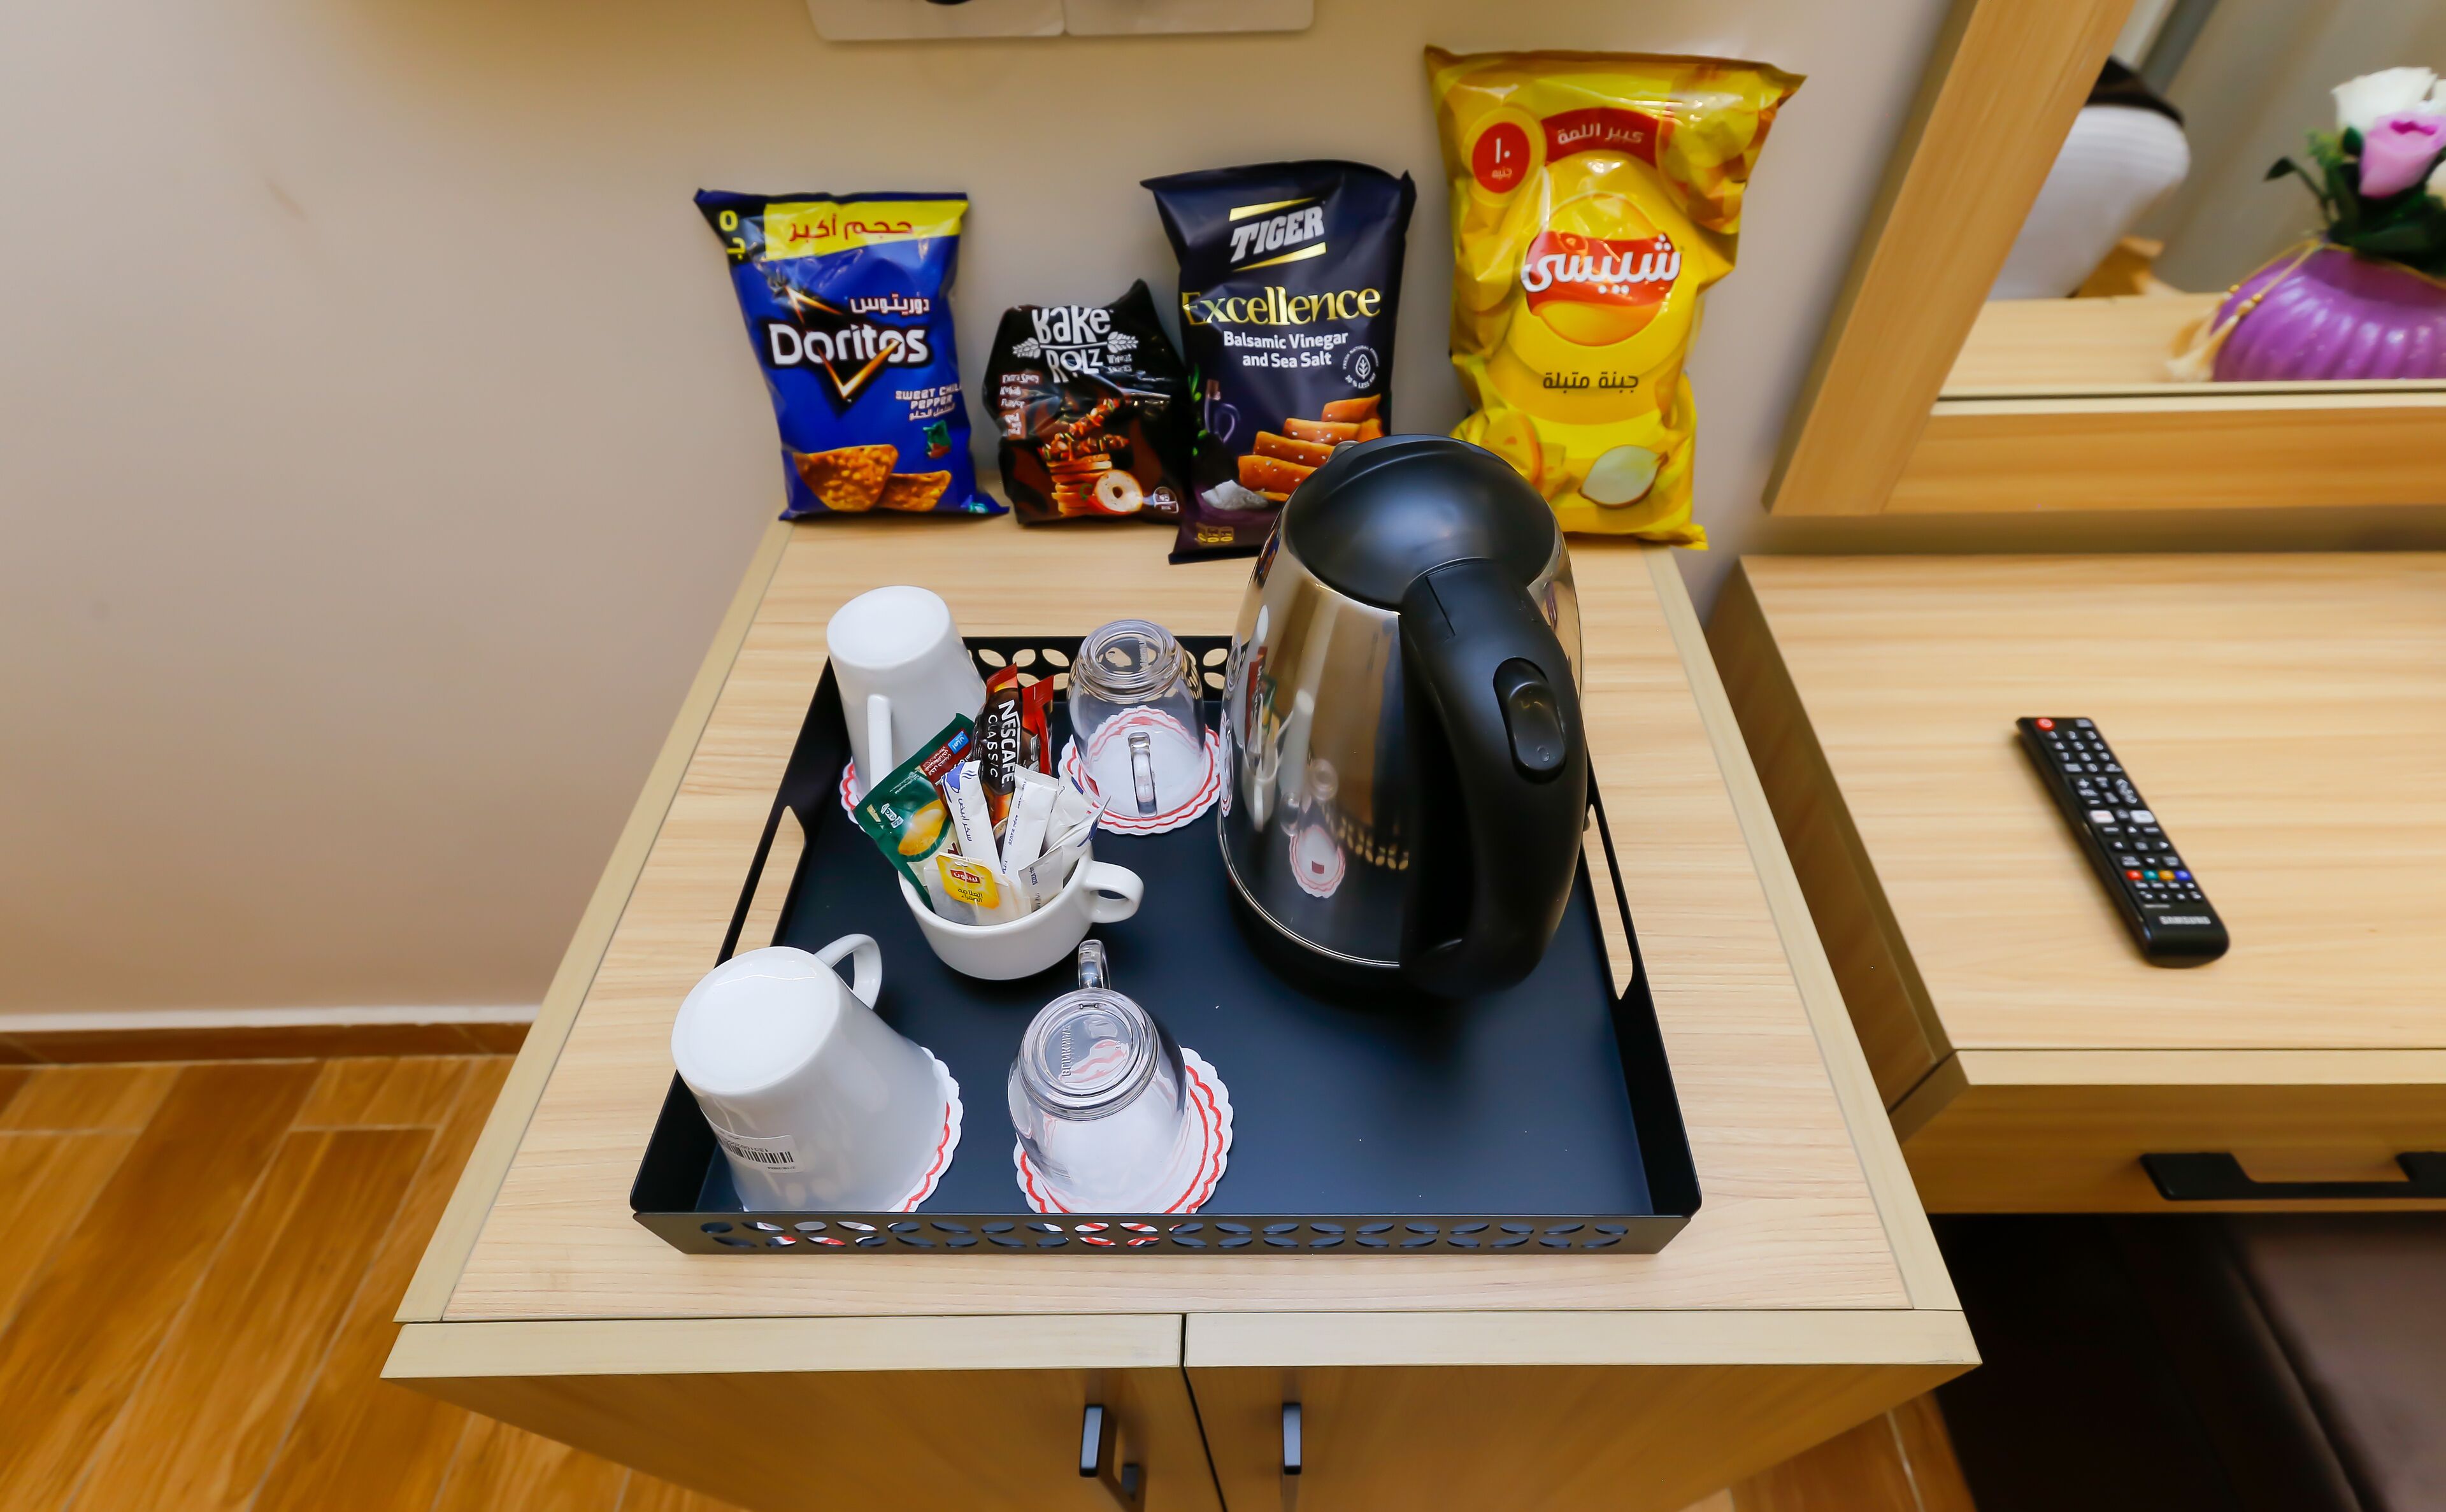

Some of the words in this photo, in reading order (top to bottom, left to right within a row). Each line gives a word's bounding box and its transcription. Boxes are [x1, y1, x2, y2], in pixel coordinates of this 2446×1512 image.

[788, 213, 837, 243] أكبر
[844, 220, 914, 240] حجم
[1229, 205, 1325, 264] TIGER
[850, 293, 930, 315] دوريتوس
[1181, 286, 1381, 326] Excellence
[768, 322, 927, 366] Doritos
[1223, 331, 1287, 349] Balsamic
[1289, 332, 1349, 350] Vinegar
[1242, 352, 1269, 367] and
[1271, 353, 1298, 368] Sea
[1300, 350, 1332, 367] Salt
[1542, 371, 1590, 394] متبلة
[1598, 371, 1639, 394] جبنة
[895, 387, 936, 401] SWEET
[910, 394, 953, 410] PEPPER
[987, 714, 999, 778] CLASSIC
[962, 822, 973, 842] سكر
